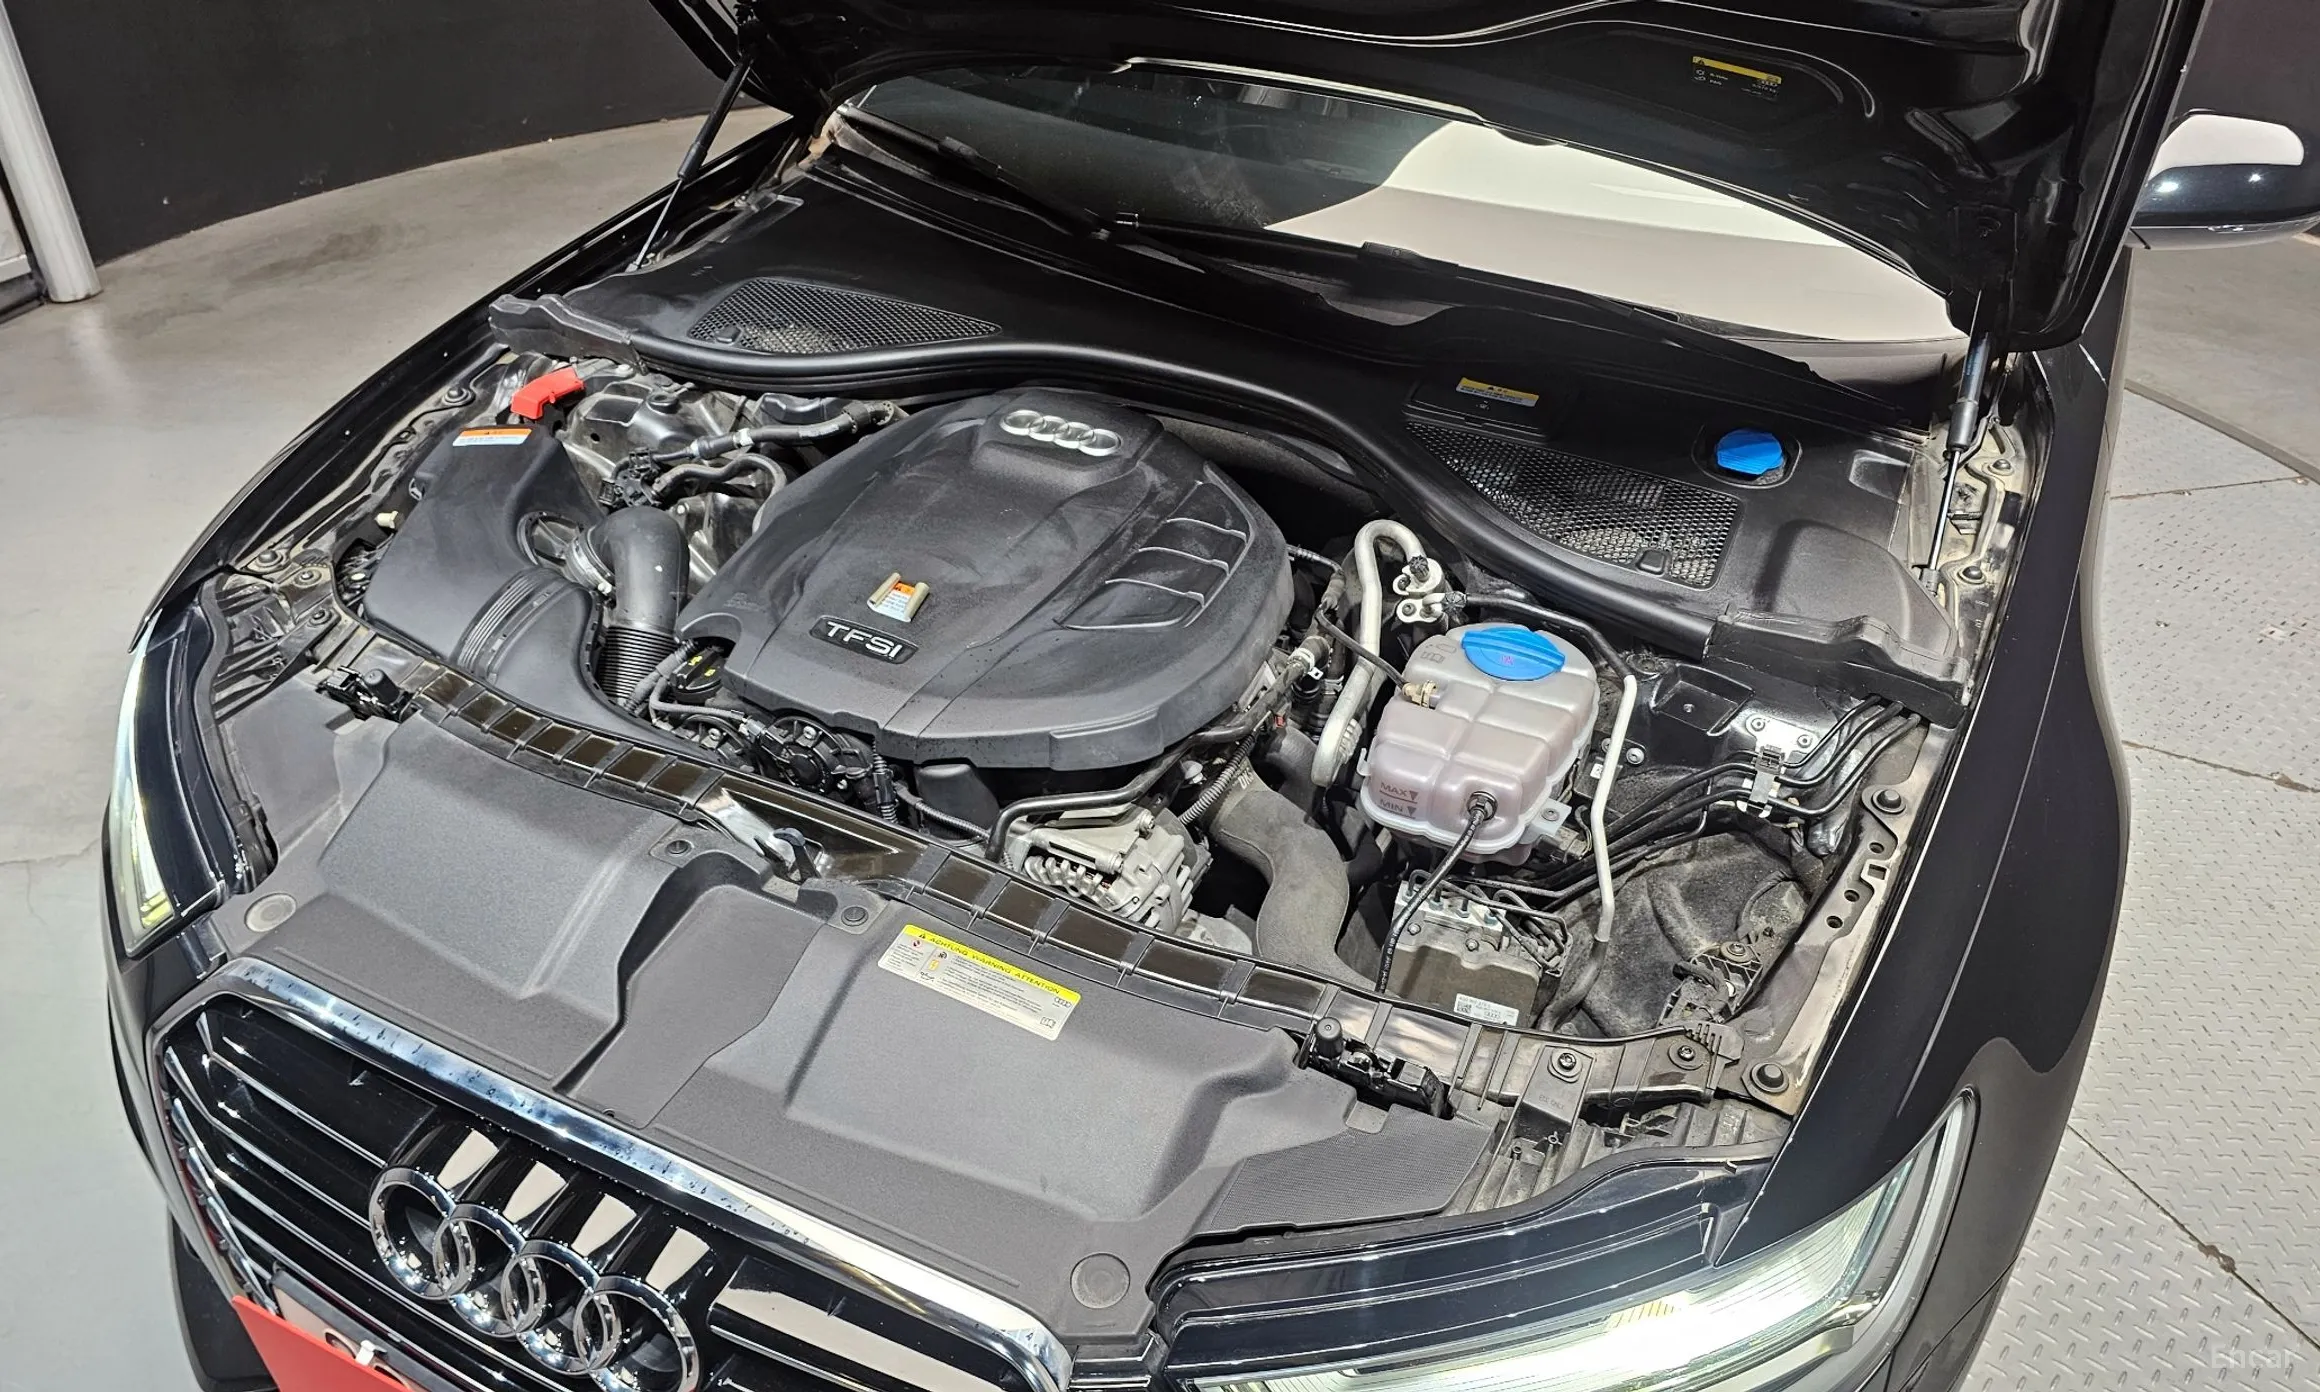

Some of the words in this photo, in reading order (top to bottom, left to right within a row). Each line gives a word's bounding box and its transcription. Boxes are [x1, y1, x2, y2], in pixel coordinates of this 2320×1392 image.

[826, 621, 903, 658] TFSI
[1380, 782, 1407, 796] MAX
[1379, 799, 1403, 812] MIN
[929, 936, 969, 955] ACHTUNG
[971, 954, 1011, 974] WARNING
[1015, 972, 1061, 994] ATTENTION
